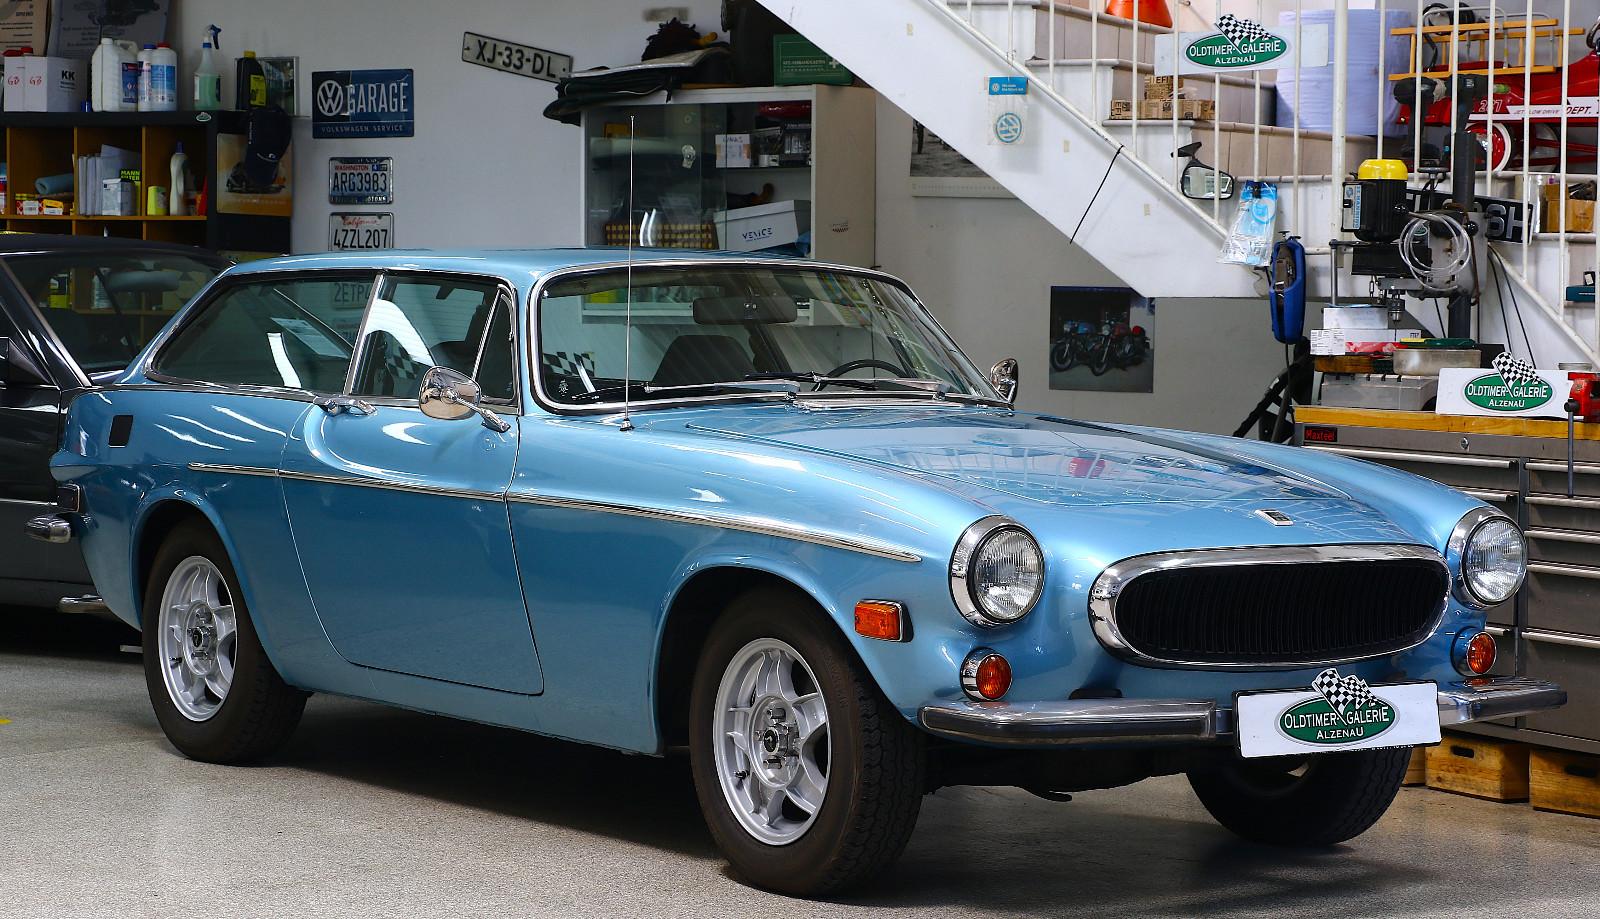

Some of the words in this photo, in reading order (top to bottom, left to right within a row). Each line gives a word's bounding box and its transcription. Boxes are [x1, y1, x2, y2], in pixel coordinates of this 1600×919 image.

[1241, 39, 1281, 54] GALERIE
[475, 39, 556, 78] XJ-33-DL
[1215, 55, 1256, 64] ALZENAU
[61, 70, 75, 81] KK
[345, 82, 408, 115] GARAGE
[1478, 99, 1503, 113] 27
[321, 124, 370, 134] VOLKSWAGEN
[372, 124, 404, 133] SERVICE
[333, 172, 387, 192] ARG3983
[333, 228, 388, 249] 4ZZL207
[1513, 383, 1548, 399] GALERIE
[1488, 398, 1525, 408] ALZENAU
[1346, 706, 1390, 724] GALERIE
[1316, 726, 1364, 740] ALZENAU
